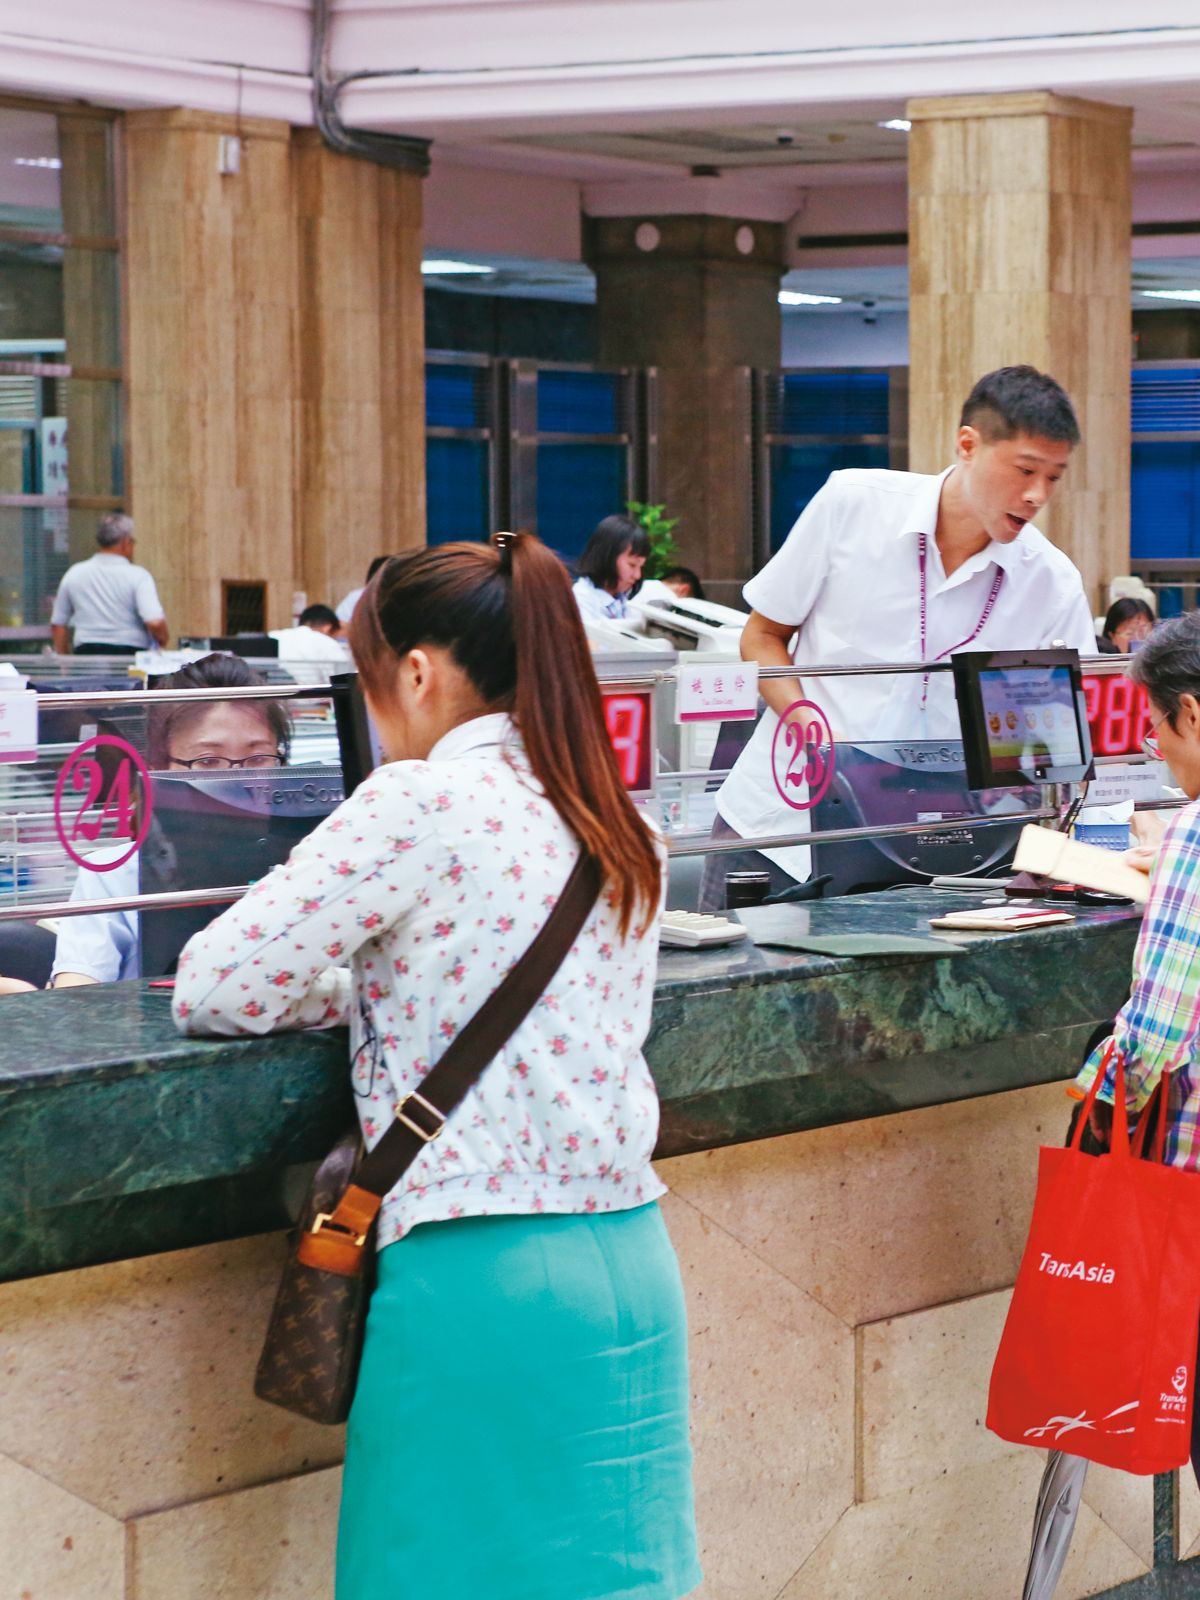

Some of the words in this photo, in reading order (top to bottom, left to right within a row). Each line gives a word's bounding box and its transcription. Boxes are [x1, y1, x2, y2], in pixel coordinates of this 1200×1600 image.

[784, 720, 825, 788] 23
[893, 747, 966, 763] ViewSo
[72, 758, 135, 841] 24
